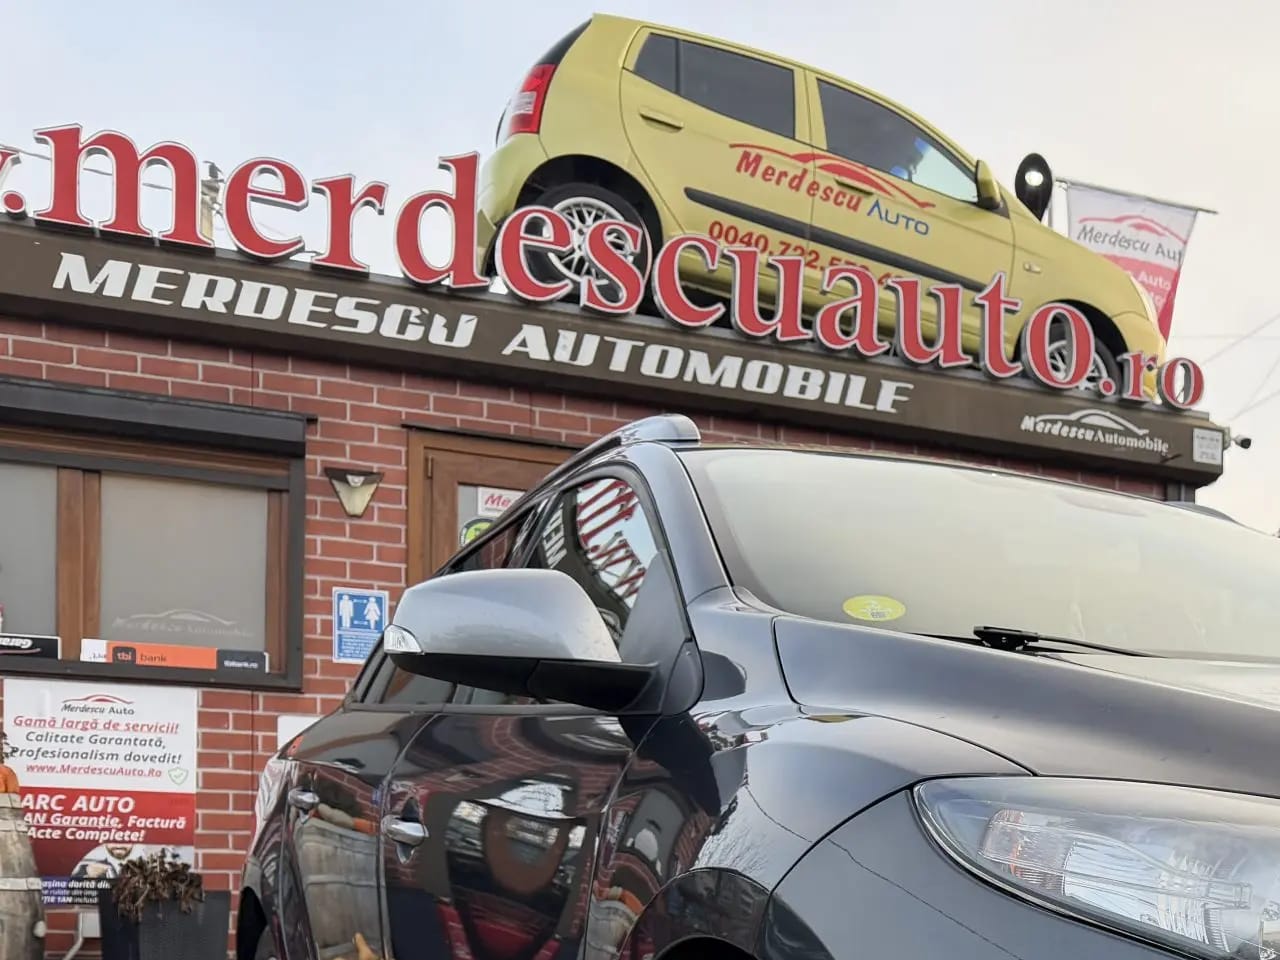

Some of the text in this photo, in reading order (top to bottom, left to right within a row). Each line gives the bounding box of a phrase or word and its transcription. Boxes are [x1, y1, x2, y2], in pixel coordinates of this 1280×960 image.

[736, 150, 863, 212] Merdescu
[1076, 224, 1151, 253] Merdescu
[0, 122, 1206, 410] .merdescuauto.ro
[53, 252, 915, 414] MERDESCU AUTOMOBILE
[61, 703, 135, 716] Merdescu Auto
[13, 714, 57, 729] Gamă
[103, 719, 120, 730] de
[125, 722, 179, 735] servicii!
[25, 731, 85, 745] Calitate
[124, 751, 182, 765] dovedit!
[71, 795, 136, 813] AUTO
[127, 815, 187, 830] Factură
[27, 827, 146, 843] Acte Complete!
